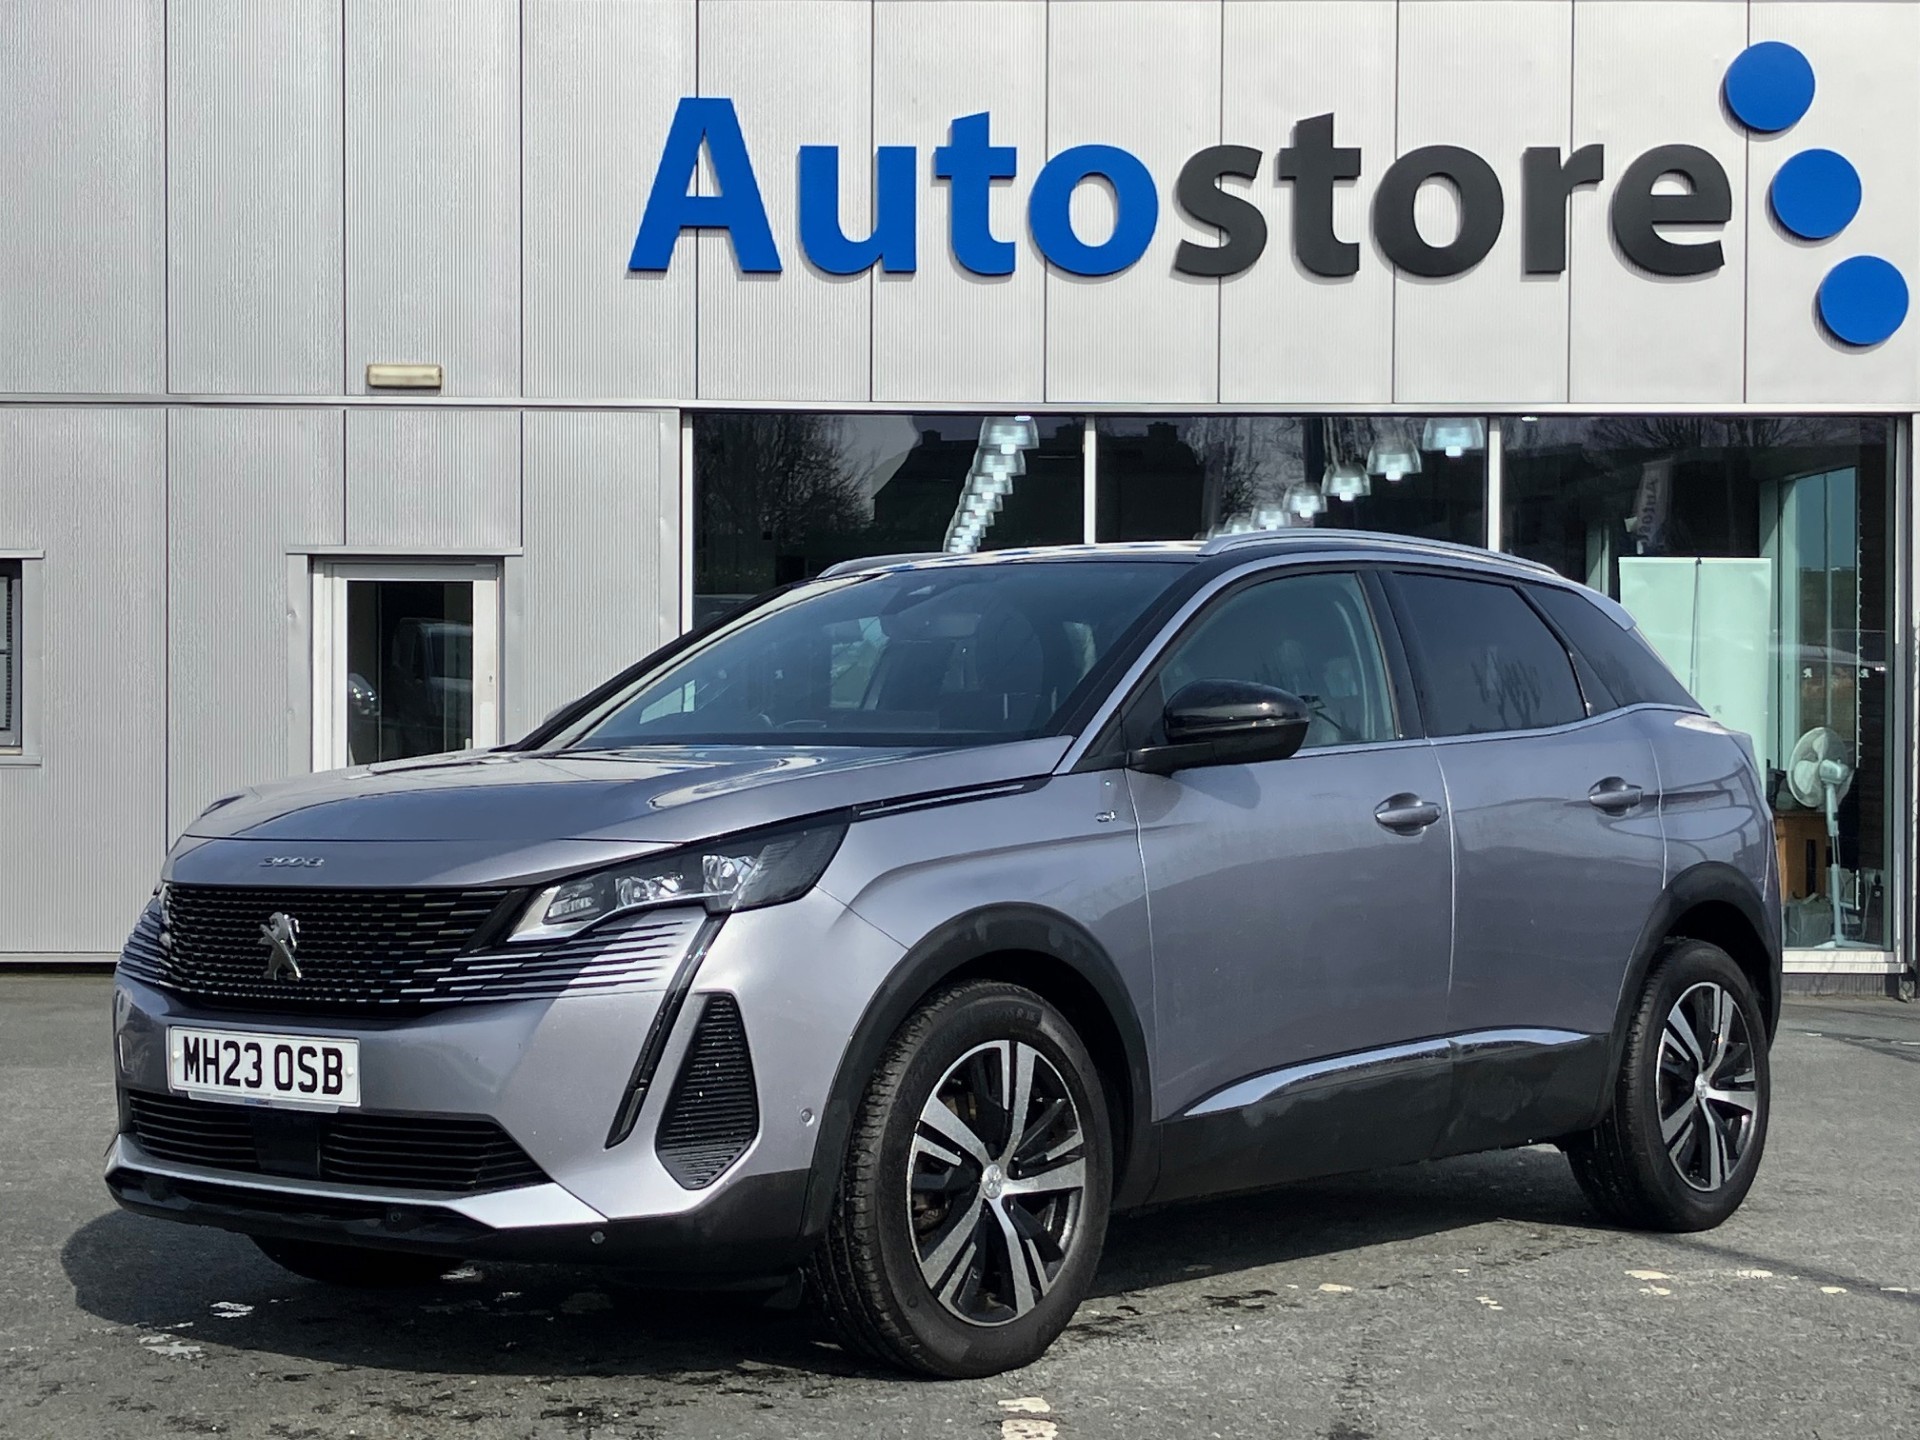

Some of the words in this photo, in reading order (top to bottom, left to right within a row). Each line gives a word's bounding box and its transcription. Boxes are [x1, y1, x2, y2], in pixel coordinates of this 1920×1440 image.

[629, 98, 1732, 277] Autostore
[184, 1036, 262, 1088] MH23
[274, 1044, 343, 1095] OSB
